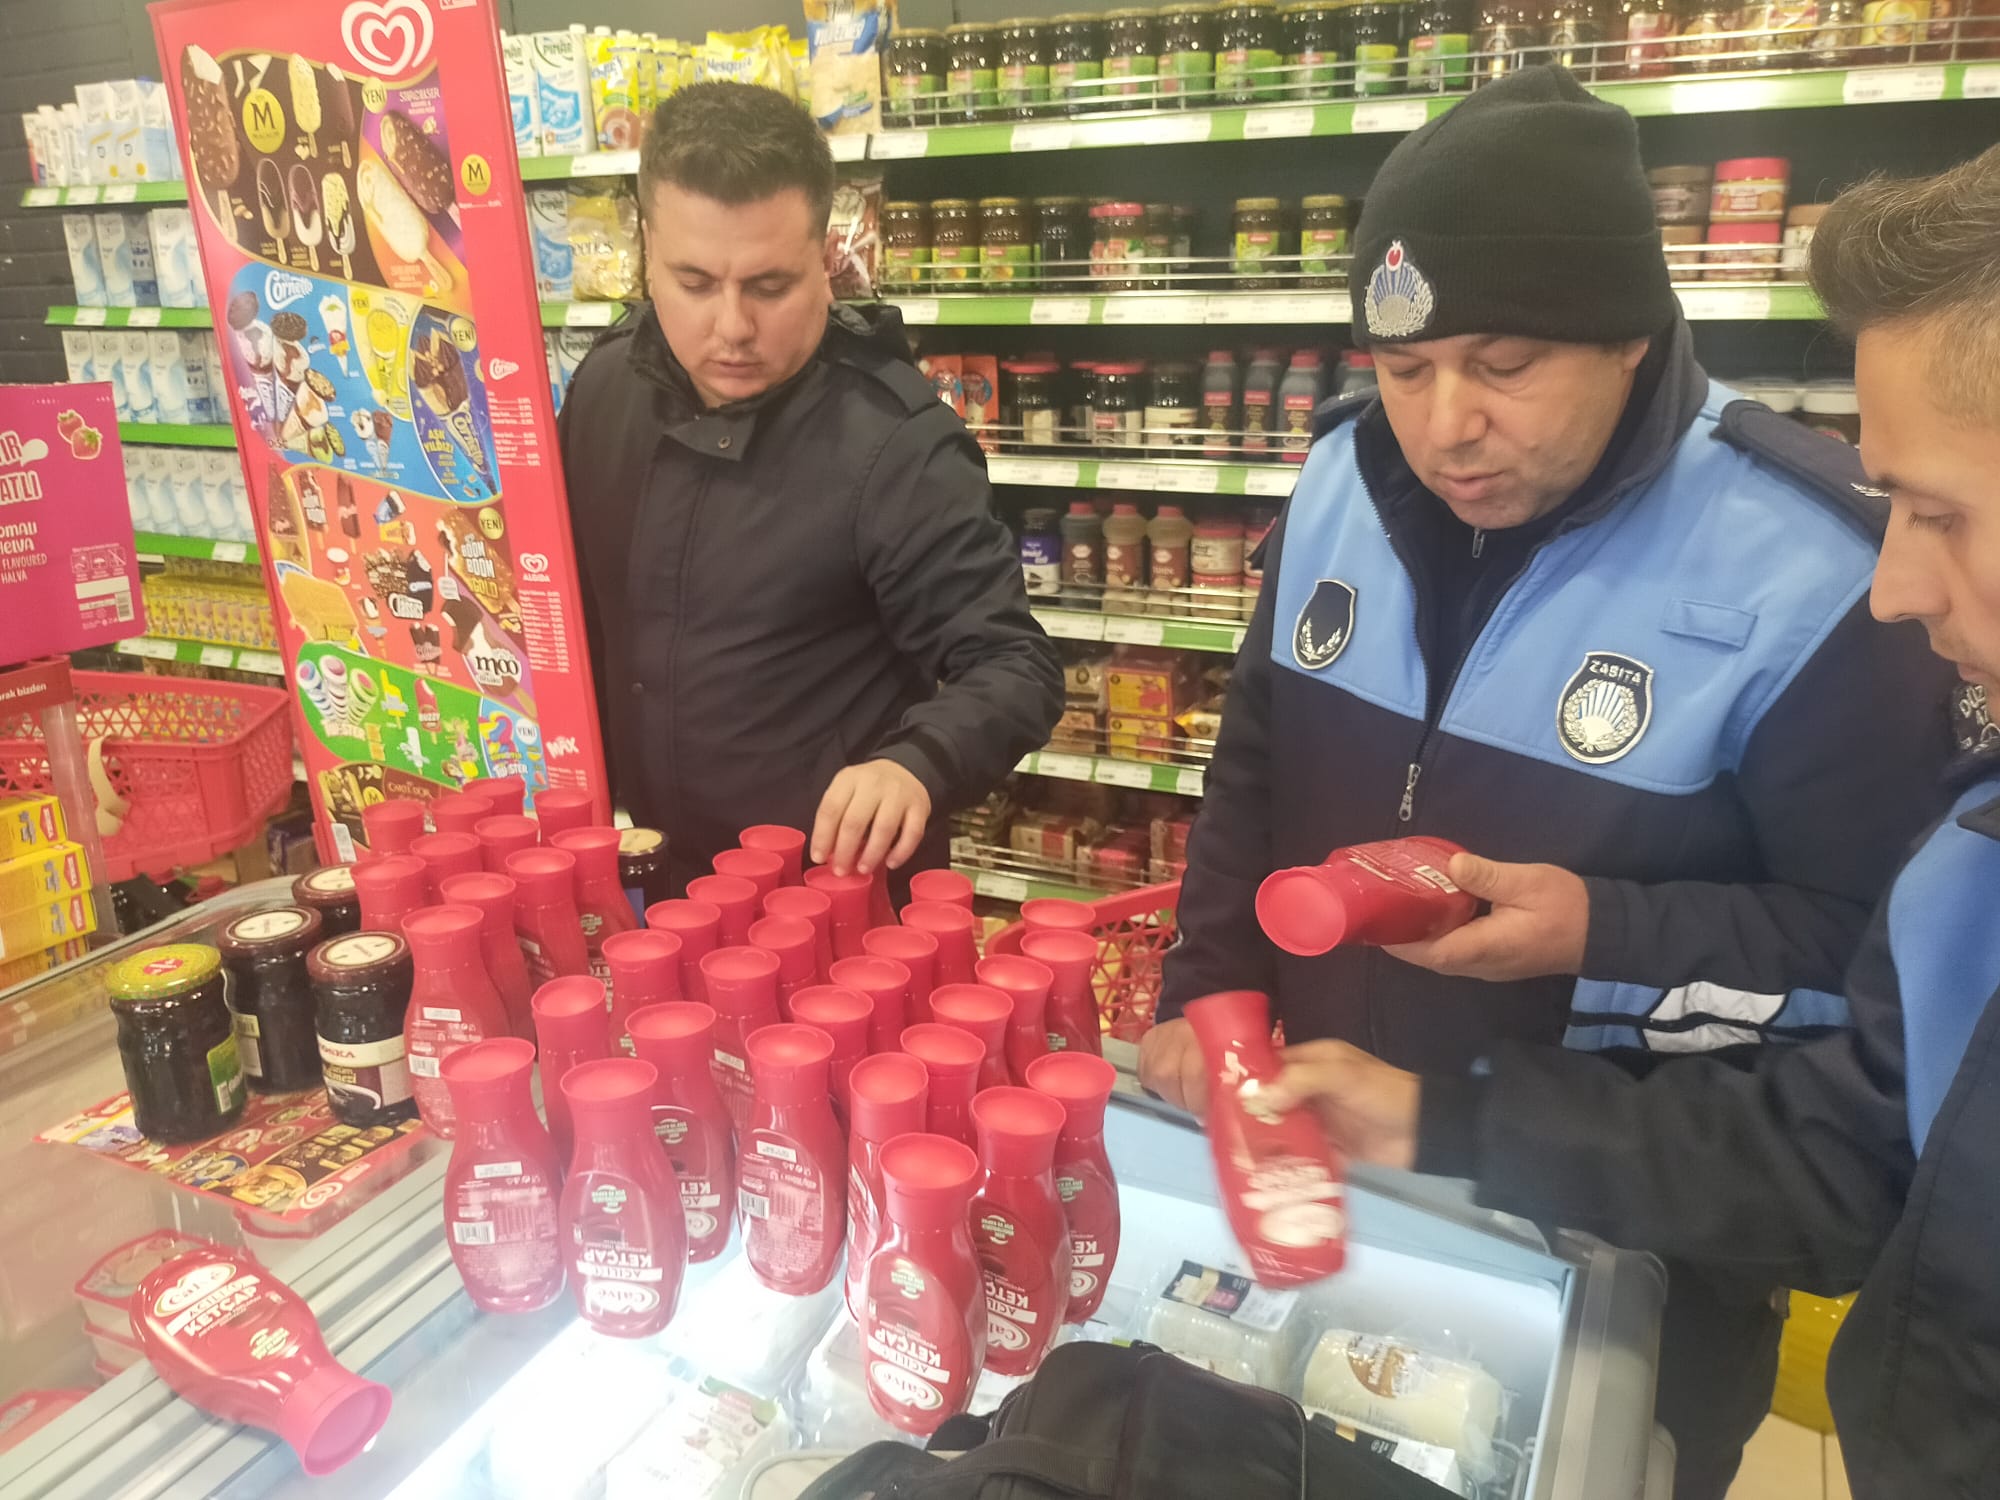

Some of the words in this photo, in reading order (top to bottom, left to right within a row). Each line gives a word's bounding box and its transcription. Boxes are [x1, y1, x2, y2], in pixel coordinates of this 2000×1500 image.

[461, 540, 486, 558] BOOM
[2, 553, 48, 570] FLAVOURED
[466, 558, 496, 578] BOOM
[1, 570, 28, 585] HALVA
[1588, 659, 1641, 684] ZABITA
[16, 682, 47, 698] bizden
[681, 1181, 711, 1195] KET
[583, 1247, 652, 1268] KETÇAP
[184, 1286, 257, 1337] KETÇAP
[987, 1298, 1016, 1316] ACIL
[988, 1322, 1017, 1341] Cal
[874, 1328, 941, 1368] KETÇAP
